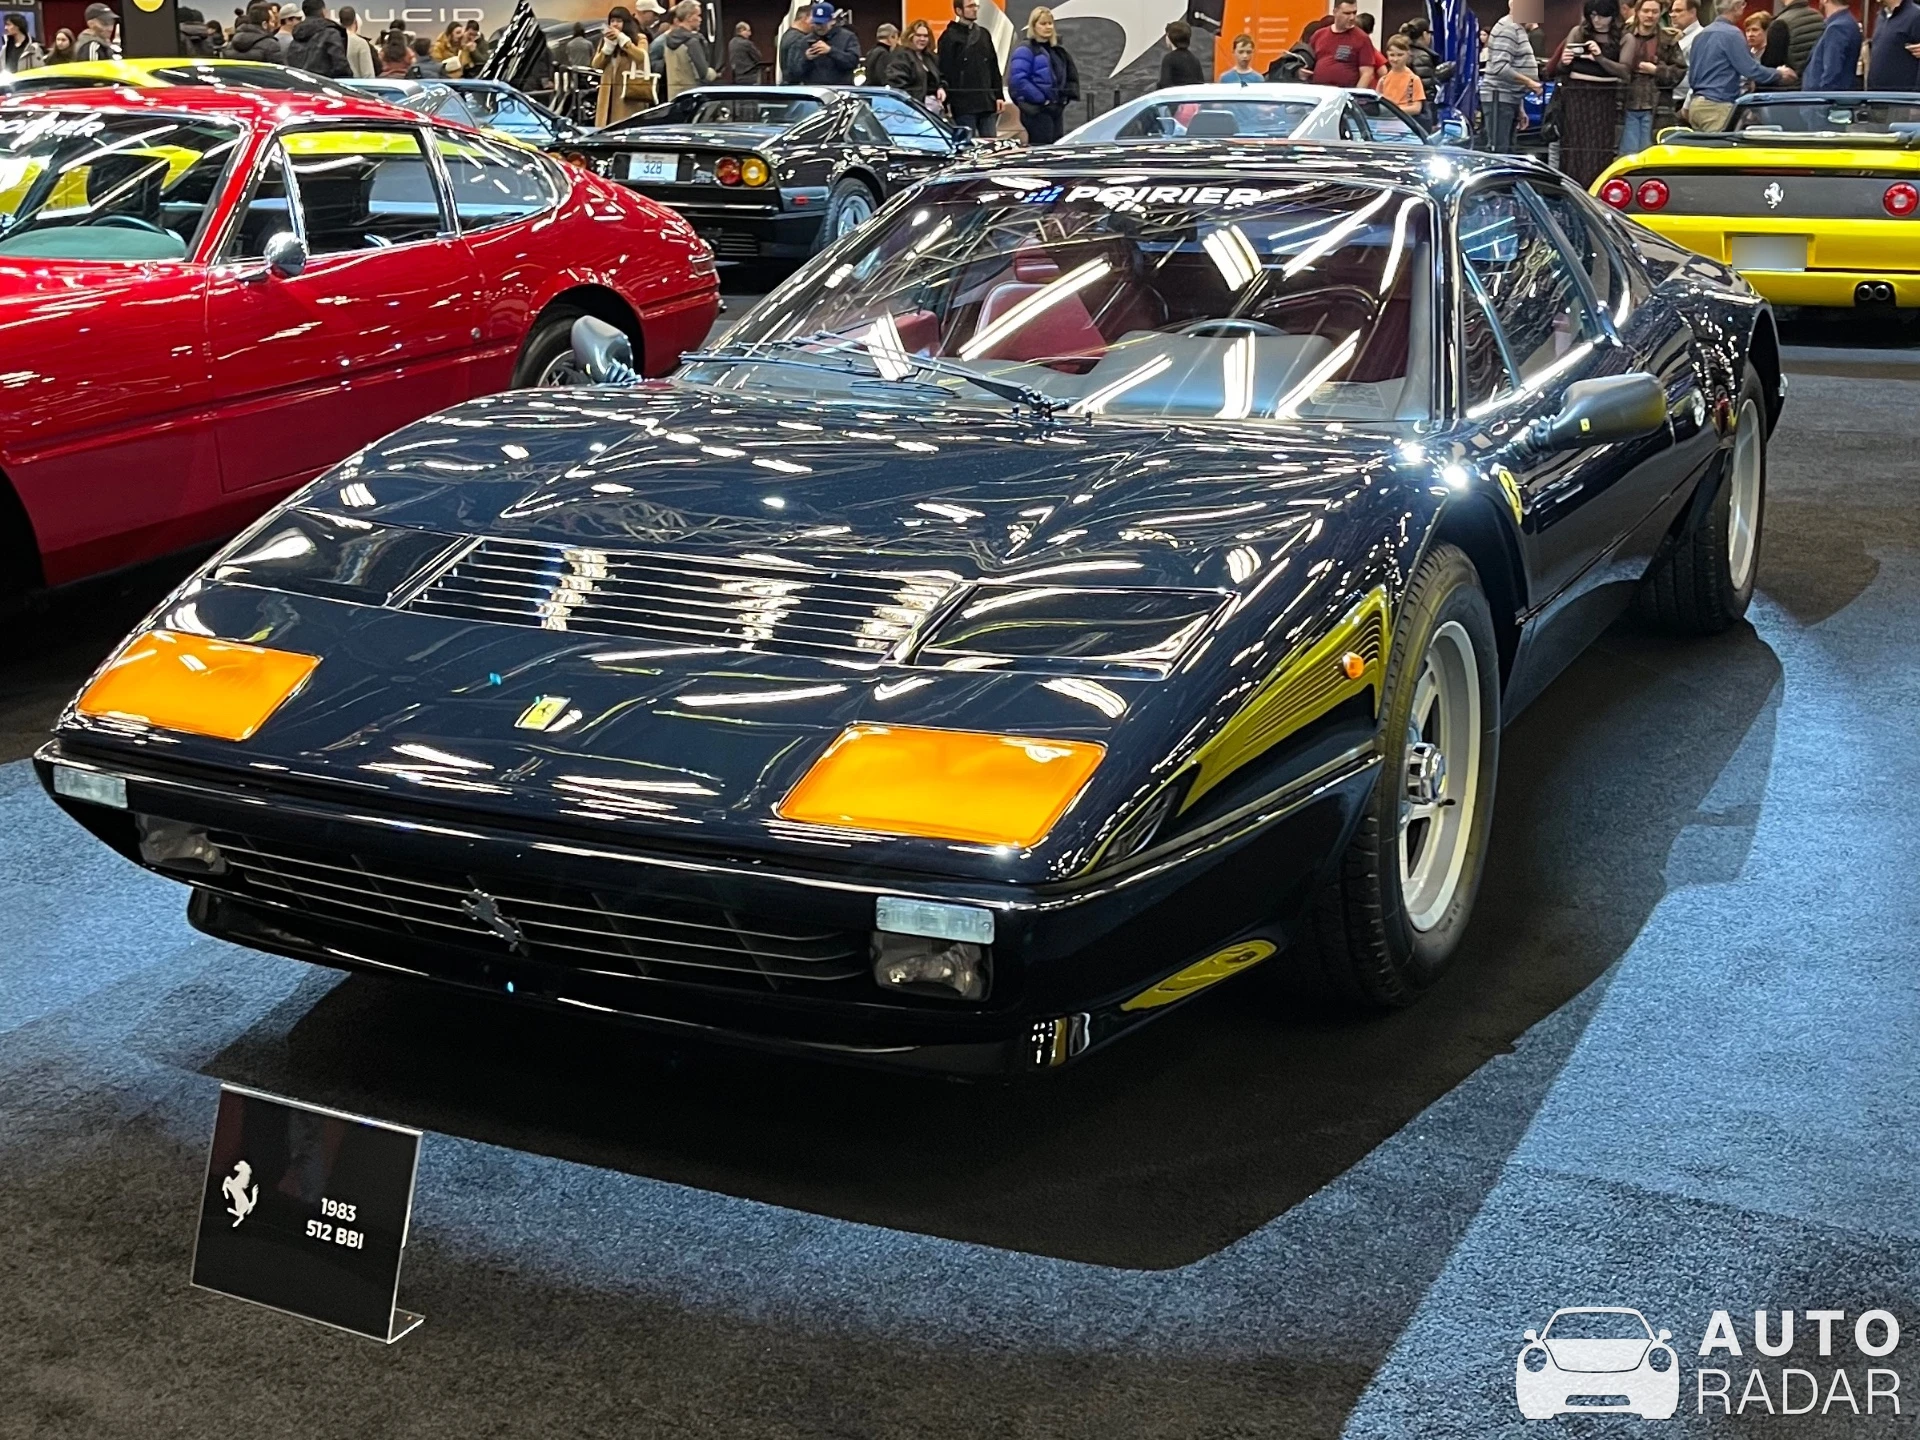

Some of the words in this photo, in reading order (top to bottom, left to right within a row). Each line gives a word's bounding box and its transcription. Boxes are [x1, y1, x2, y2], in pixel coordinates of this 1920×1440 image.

[643, 160, 663, 174] 328
[1064, 186, 1262, 205] POIRIER
[321, 1197, 357, 1222] 1983
[305, 1219, 332, 1241] 512
[335, 1227, 364, 1249] BBI
